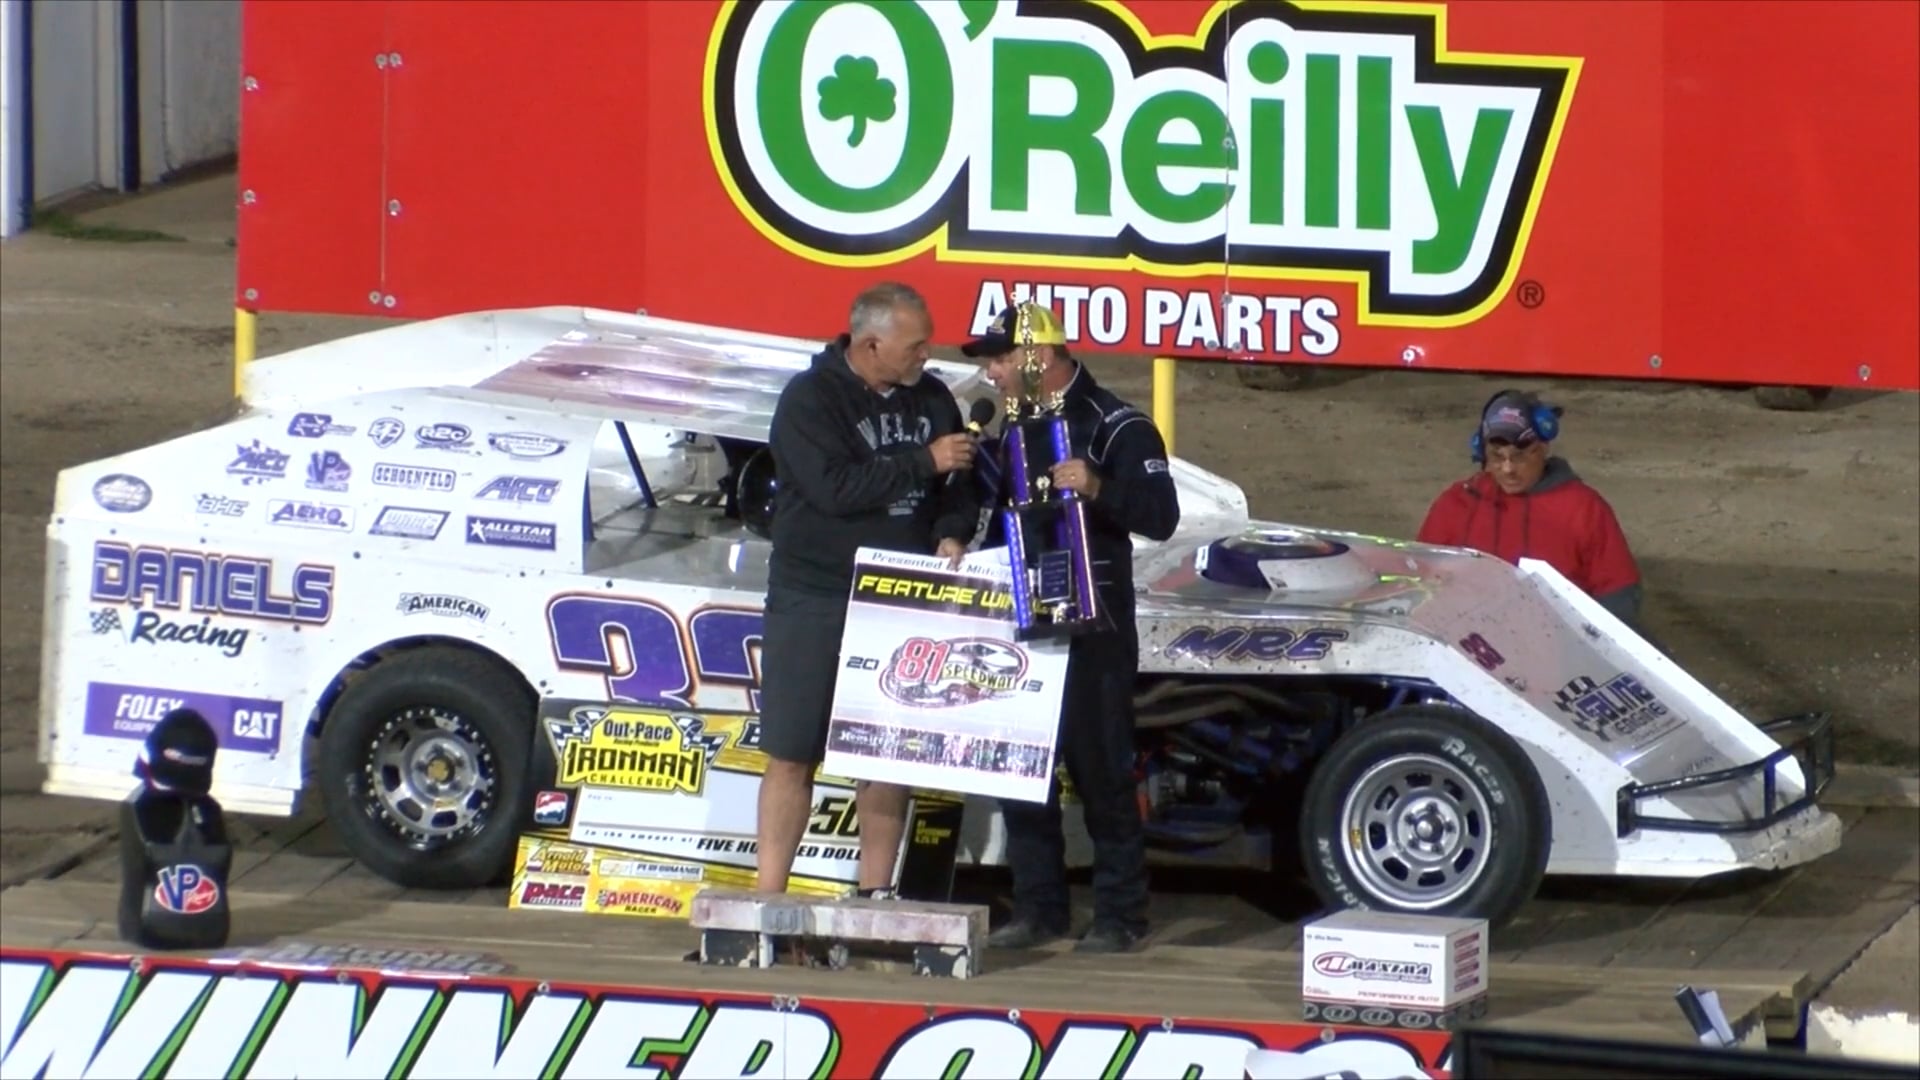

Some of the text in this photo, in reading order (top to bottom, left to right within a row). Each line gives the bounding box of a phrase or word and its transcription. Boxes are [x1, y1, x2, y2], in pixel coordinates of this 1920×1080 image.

[756, 0, 1515, 274] O'Reilly
[1144, 289, 1339, 355] PARTS
[375, 467, 452, 488] SCHOENFELD
[484, 522, 552, 537] ALLSTAR
[872, 552, 943, 569] Presented
[90, 540, 334, 626] DANIELS
[858, 575, 979, 605] FEATURE
[408, 595, 487, 619] AMERICAN
[130, 611, 249, 658] Racing
[1164, 625, 1349, 661] MRE
[846, 657, 880, 670] 20
[895, 638, 951, 685] 81
[943, 662, 1015, 691] SPEEDWAY
[233, 709, 278, 739] CAT
[603, 719, 674, 741] Out-Pace
[565, 742, 701, 787] IRONMAN
[590, 773, 672, 788] CHALLENGE
[697, 838, 732, 852] FIVE
[637, 863, 701, 875] PERFORMANCE
[157, 864, 202, 911] VP
[604, 891, 683, 914] AMERICAN
[624, 905, 657, 914] RACER
[1347, 959, 1431, 975] MAXIMA
